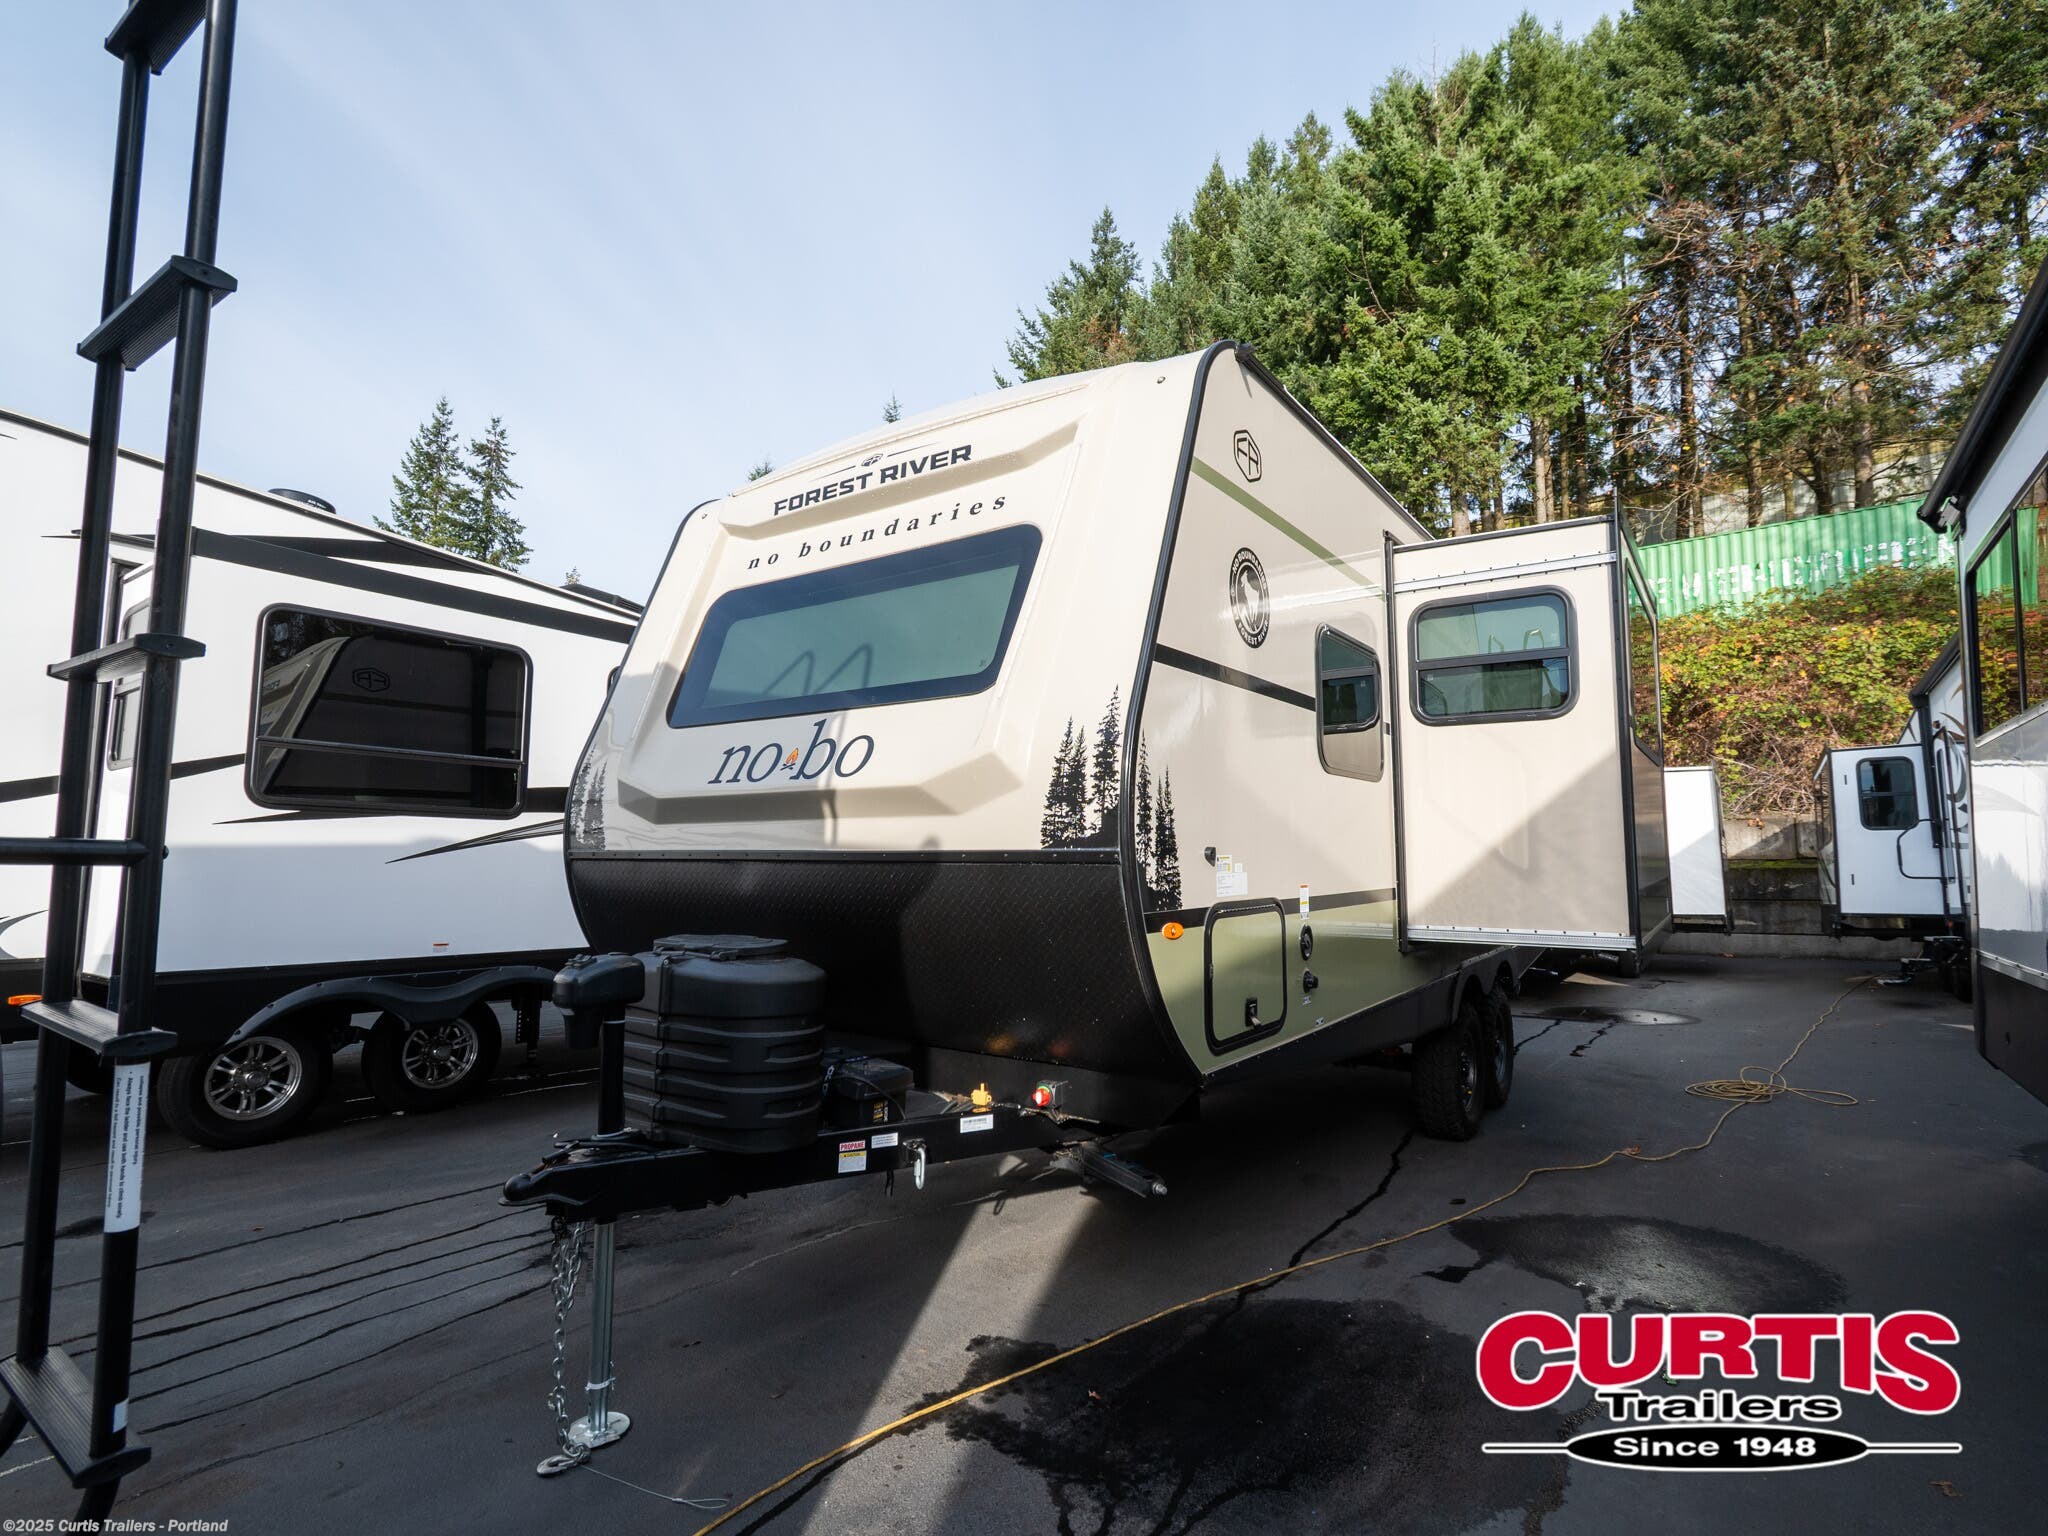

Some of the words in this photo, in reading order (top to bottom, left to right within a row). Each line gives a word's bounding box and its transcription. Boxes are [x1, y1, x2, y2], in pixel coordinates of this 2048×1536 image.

[773, 471, 873, 517] FOREST
[880, 443, 972, 485] RIVER
[747, 553, 779, 570] no
[798, 495, 1006, 559] boundaries
[840, 1141, 865, 1151] PROPANE
